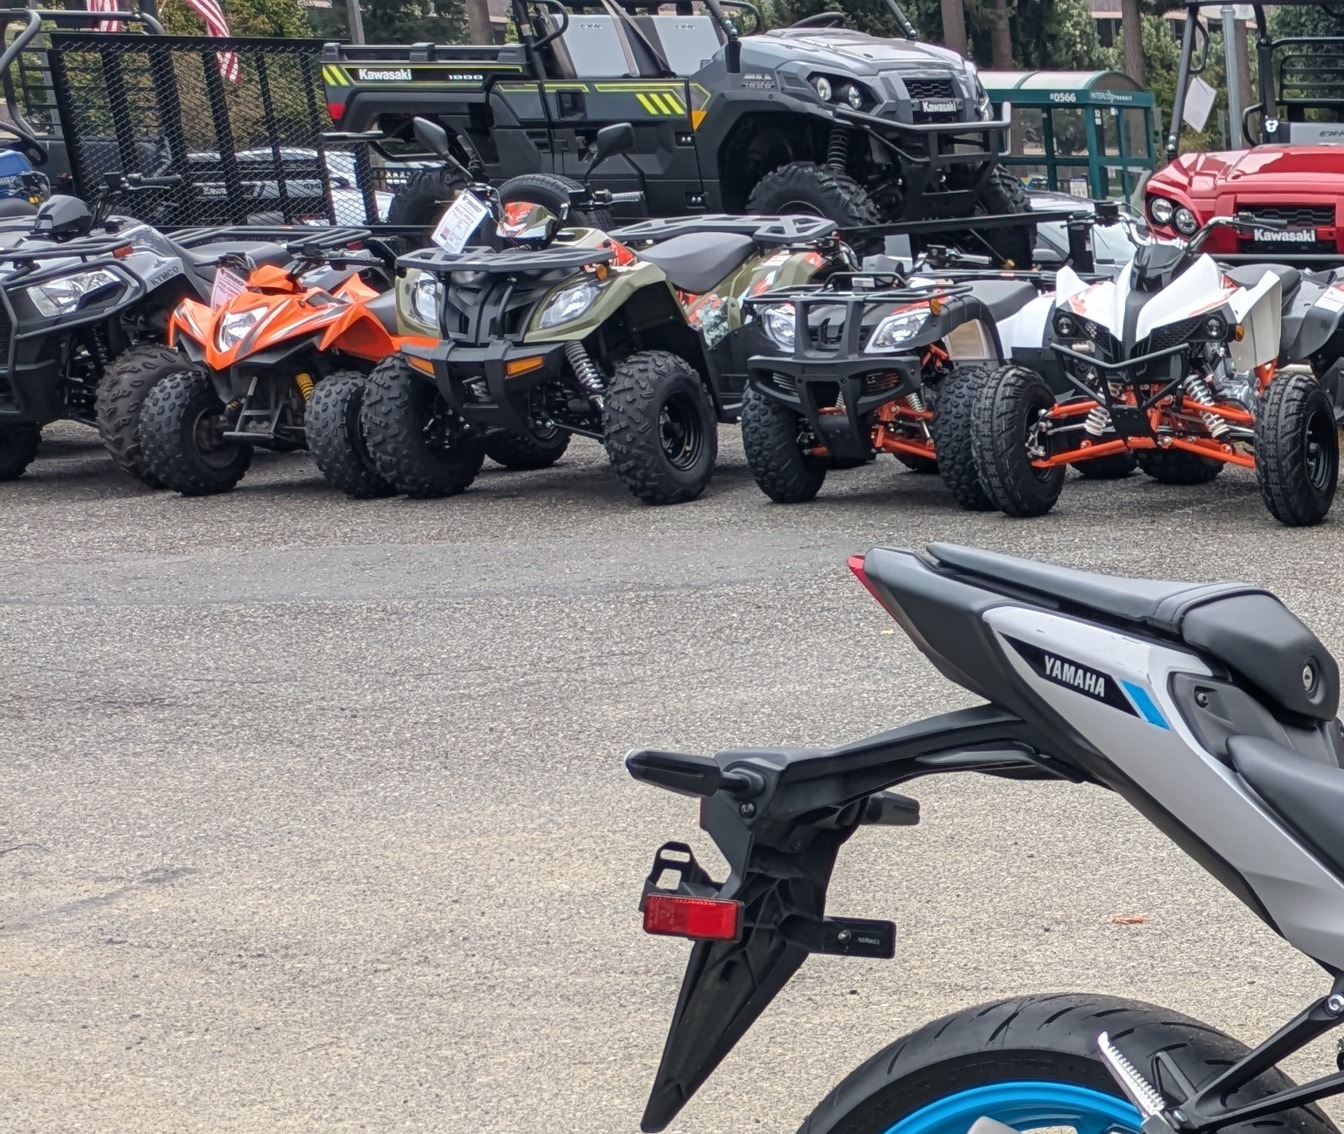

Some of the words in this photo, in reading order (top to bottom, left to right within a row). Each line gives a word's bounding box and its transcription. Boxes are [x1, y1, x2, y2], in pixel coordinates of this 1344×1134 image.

[359, 68, 412, 80] Kawasaki
[1049, 92, 1077, 103] #0566
[922, 101, 957, 112] Kawasaki
[1254, 229, 1316, 242] Kawasaki
[150, 266, 179, 286] KYMCO
[1044, 655, 1105, 697] YAMAHA
